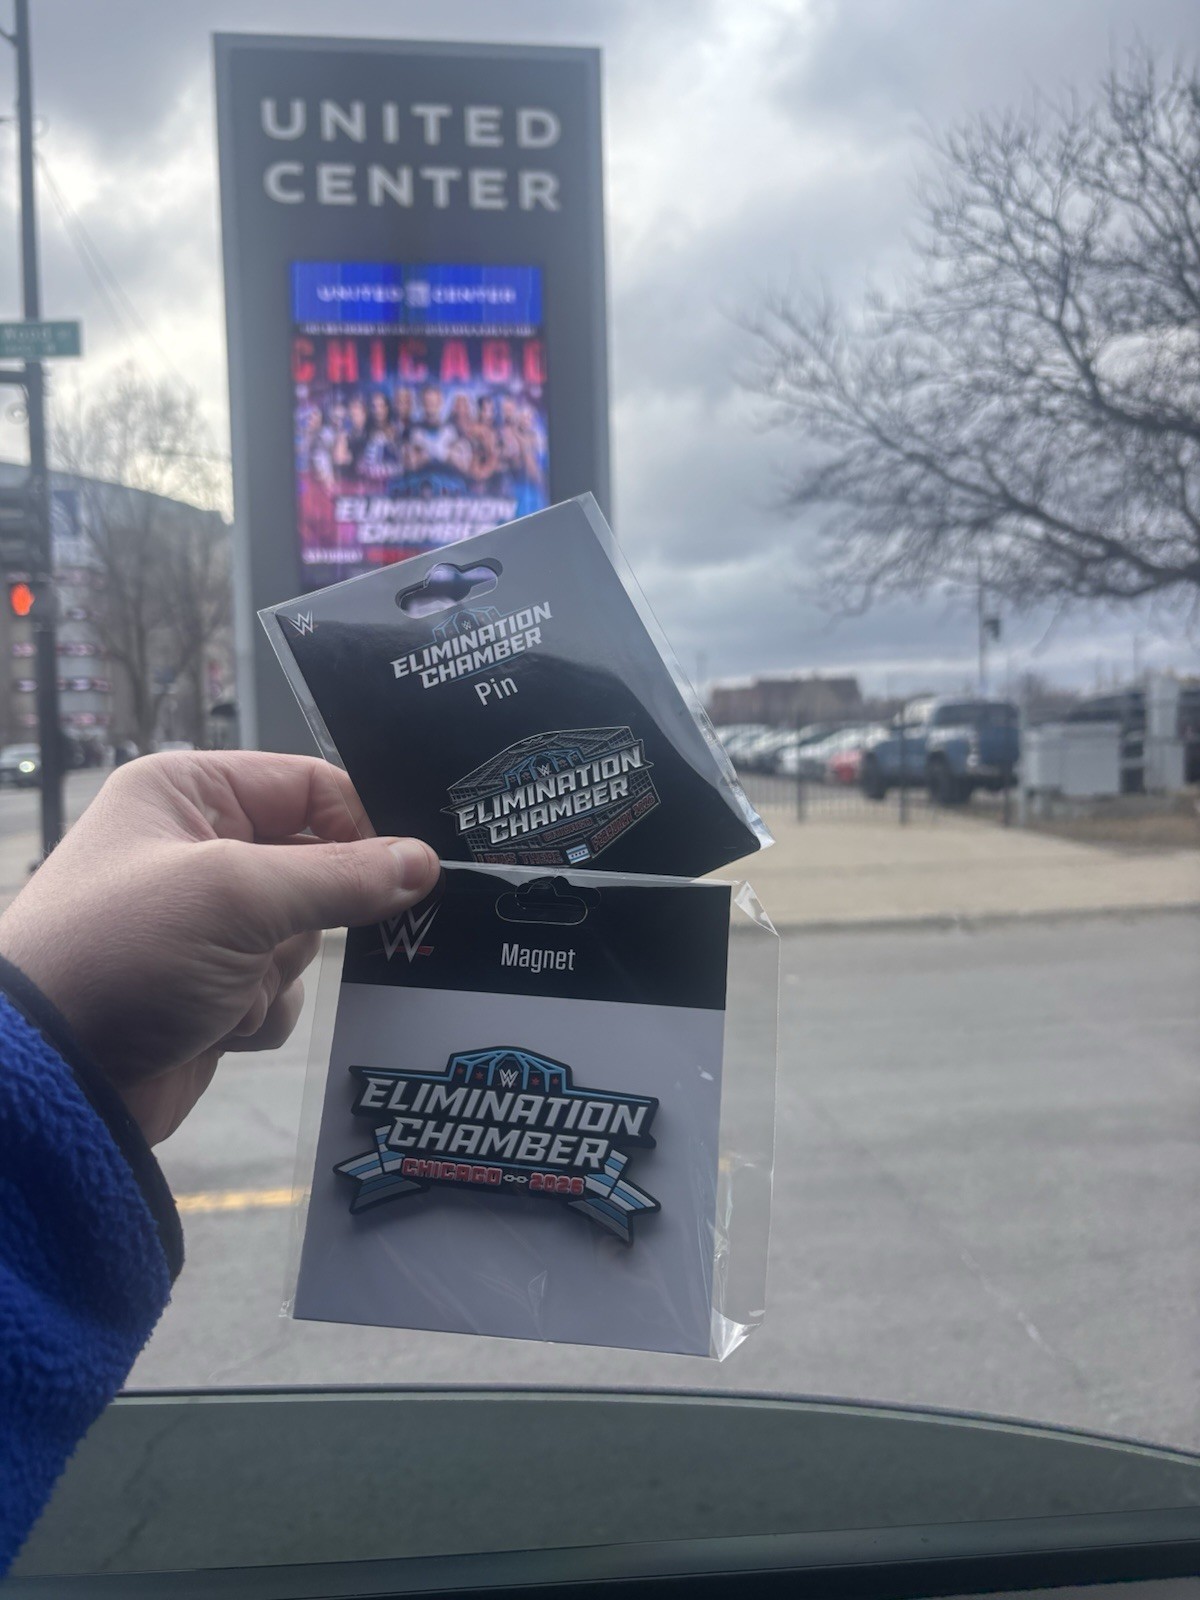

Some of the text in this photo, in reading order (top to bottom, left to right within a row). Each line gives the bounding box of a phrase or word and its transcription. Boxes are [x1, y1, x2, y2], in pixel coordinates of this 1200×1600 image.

[261, 99, 561, 148] UNITED
[263, 162, 561, 211] CENTER
[316, 285, 517, 305] UNITED CENTER
[390, 602, 552, 679] ELIMINATION
[419, 627, 542, 689] CHAMBER
[474, 676, 518, 706] Pin
[455, 745, 643, 830] ELIMINATION
[487, 775, 629, 844] CHAMBER
[501, 943, 576, 973] Magnet
[359, 1077, 648, 1137] ELIMINATION
[388, 1116, 608, 1168] CHAMBER
[402, 1158, 585, 1195] CHICAGO 2026
